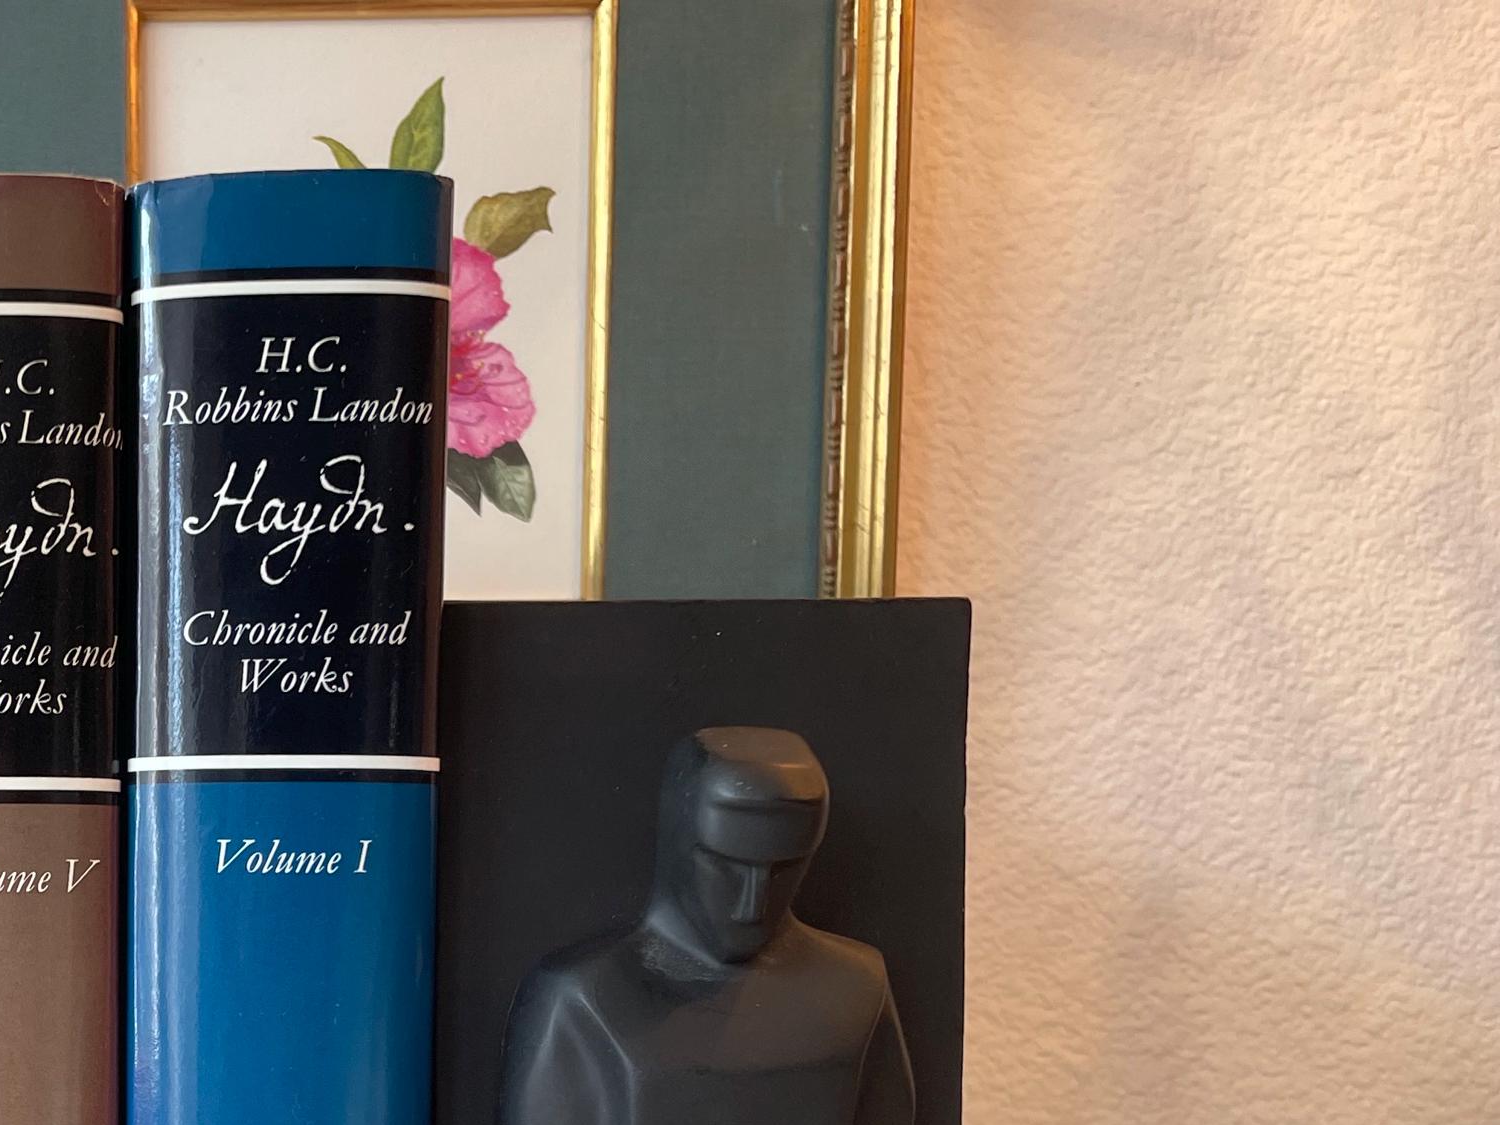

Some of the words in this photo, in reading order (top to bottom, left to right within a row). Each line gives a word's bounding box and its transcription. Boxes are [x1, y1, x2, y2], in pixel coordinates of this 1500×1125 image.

[255, 337, 346, 374] H.C.
[163, 387, 298, 426] Robbins
[308, 387, 433, 426] Landon
[183, 610, 336, 646] Chronicle
[349, 611, 408, 646] and
[63, 635, 118, 669] and
[239, 658, 353, 695] Works
[216, 839, 342, 875] Volume
[354, 840, 372, 874] I
[66, 858, 100, 893] V
